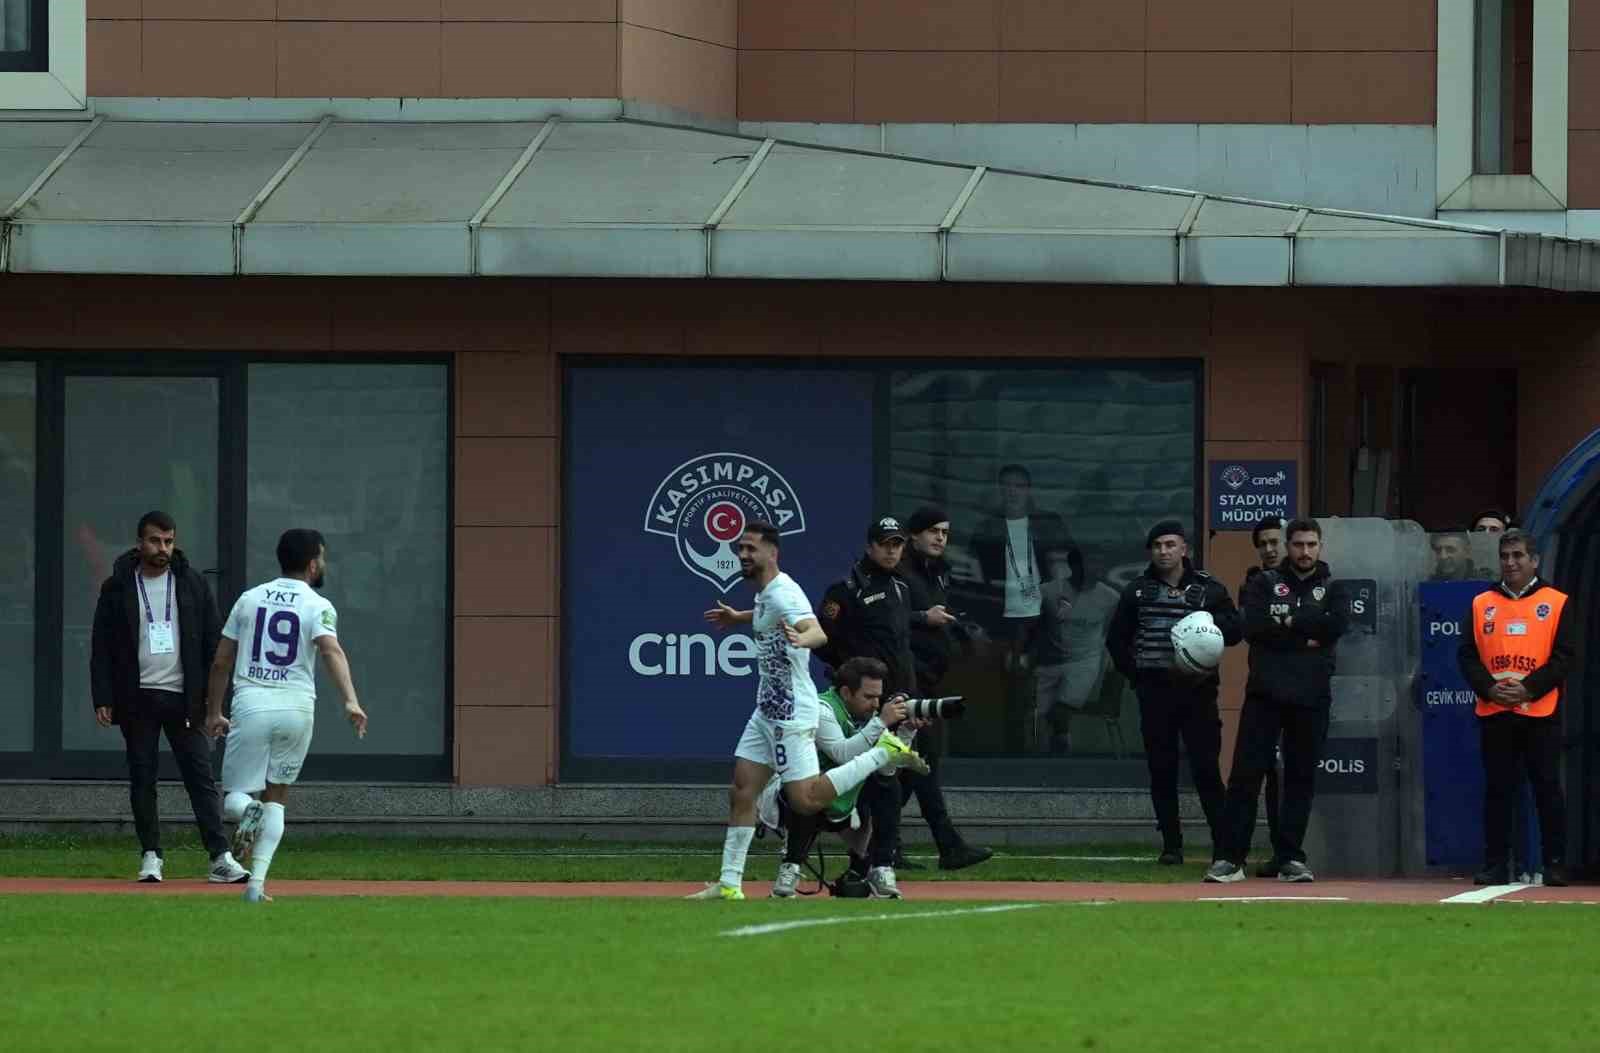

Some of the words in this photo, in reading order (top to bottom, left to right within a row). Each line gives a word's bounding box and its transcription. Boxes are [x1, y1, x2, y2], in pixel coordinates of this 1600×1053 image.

[1219, 494, 1287, 506] STADYUM
[716, 560, 734, 569] 1921
[265, 589, 300, 603] YKT
[1430, 621, 1462, 635] POL
[252, 607, 301, 667] 19
[628, 633, 757, 676] cine
[247, 666, 289, 681] BOZOK
[776, 744, 787, 766] 8
